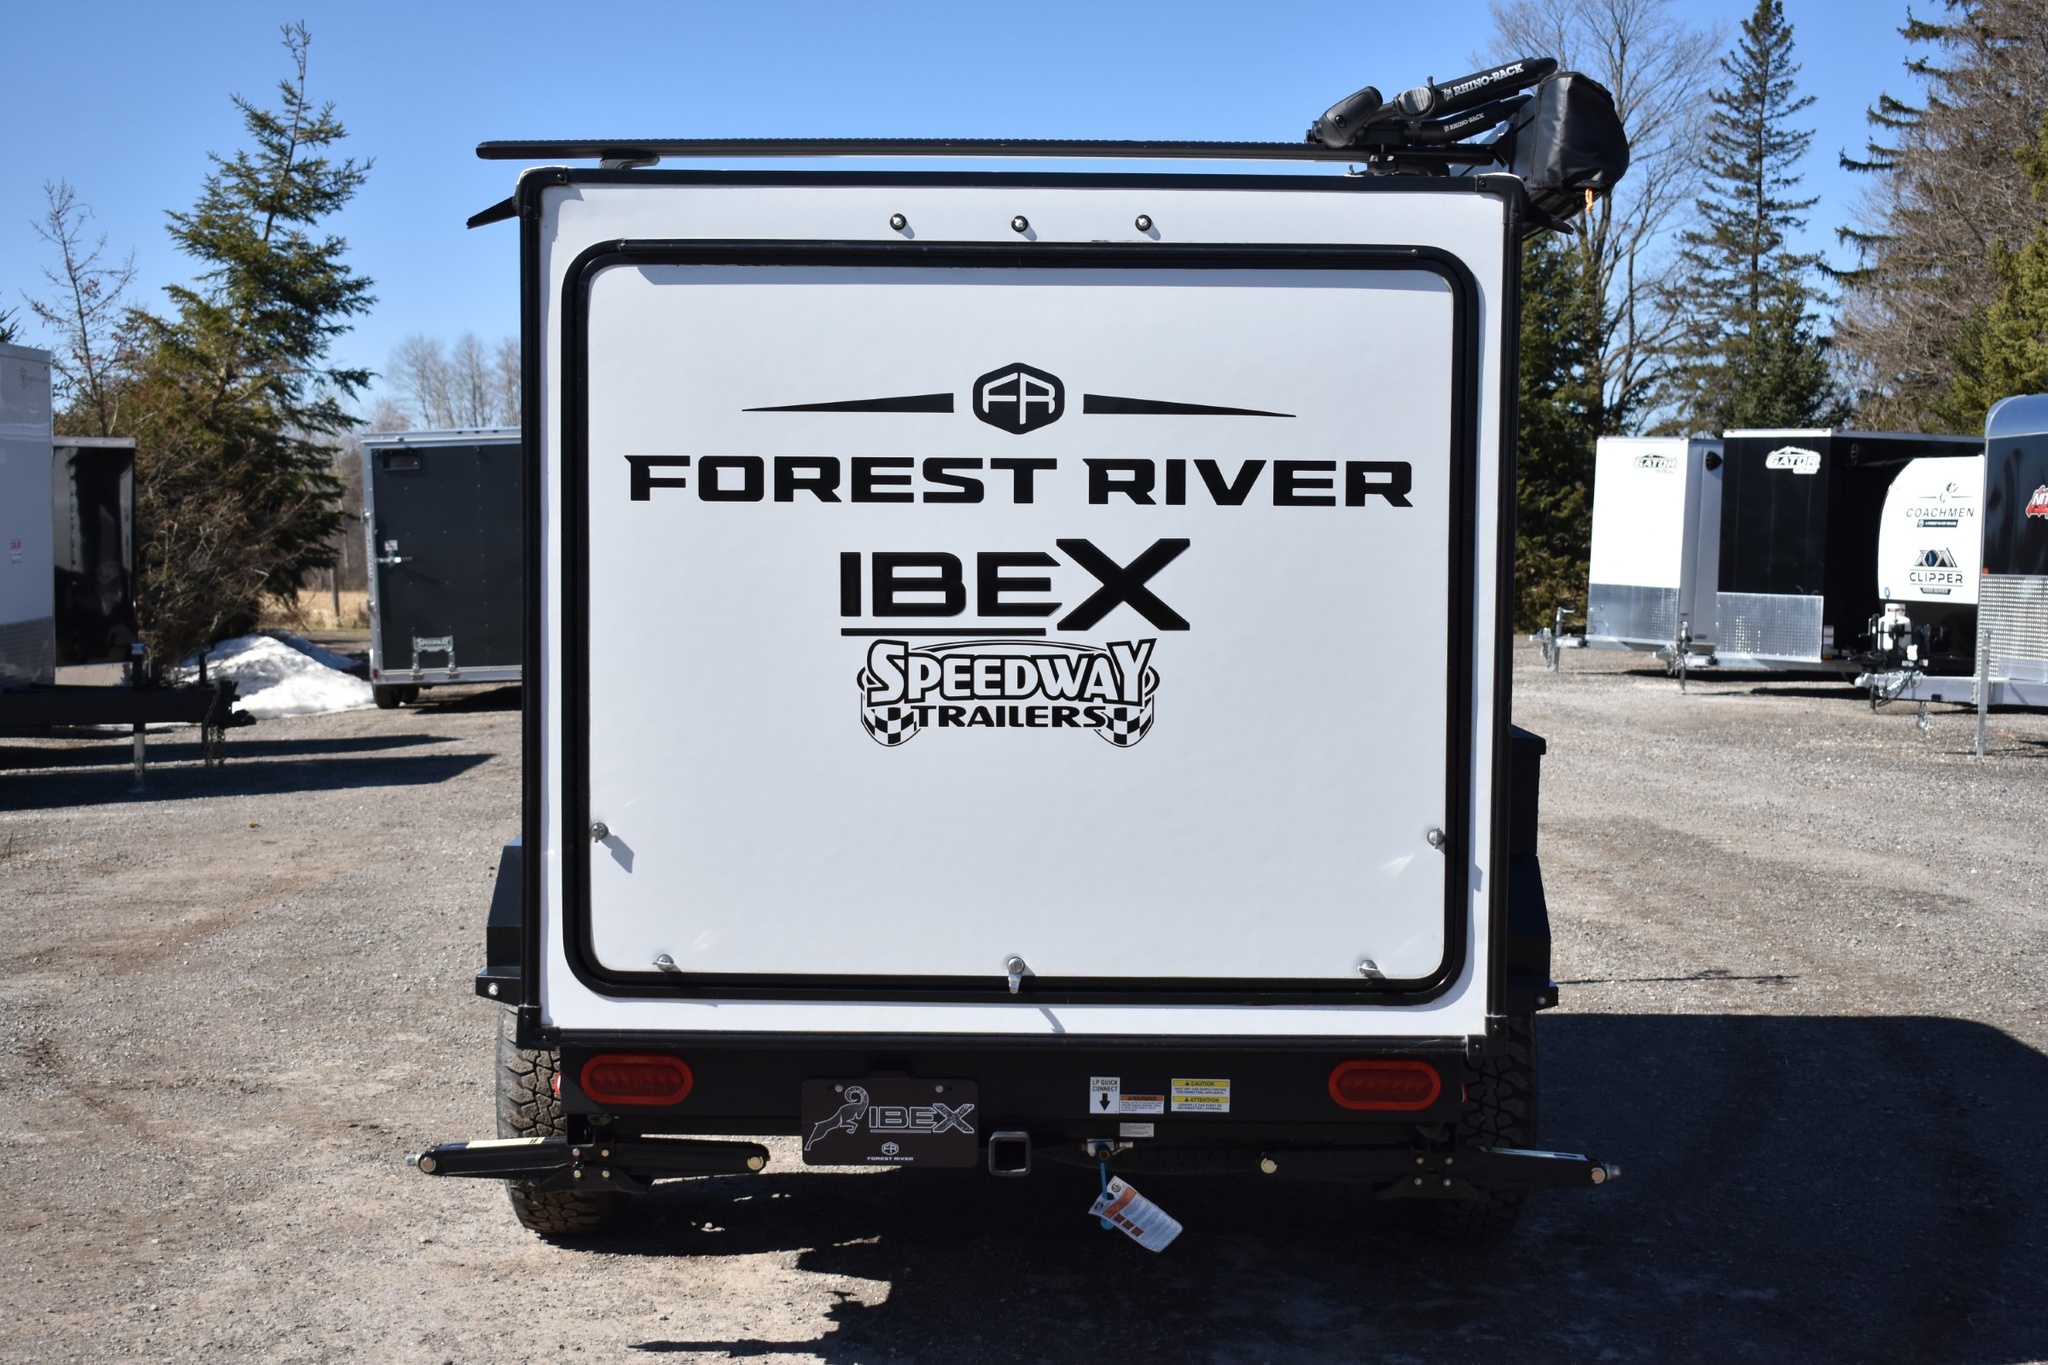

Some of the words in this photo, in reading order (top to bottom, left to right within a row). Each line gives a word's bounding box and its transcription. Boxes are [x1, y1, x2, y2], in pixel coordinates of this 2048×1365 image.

[1453, 63, 1524, 95] RHINO-RACK
[1449, 113, 1485, 130] RHINO-RACK
[1768, 455, 1818, 467] GATOR
[624, 455, 1057, 504] FOREST
[1082, 458, 1414, 508] RIVER
[1906, 507, 1975, 518] COACHMEN
[840, 538, 1191, 631] IBEX
[1909, 571, 1963, 584] CLIPPER
[866, 637, 1158, 708] SPEEDWAY
[910, 705, 1110, 728] TRAILERS
[869, 1103, 975, 1133] IBEX
